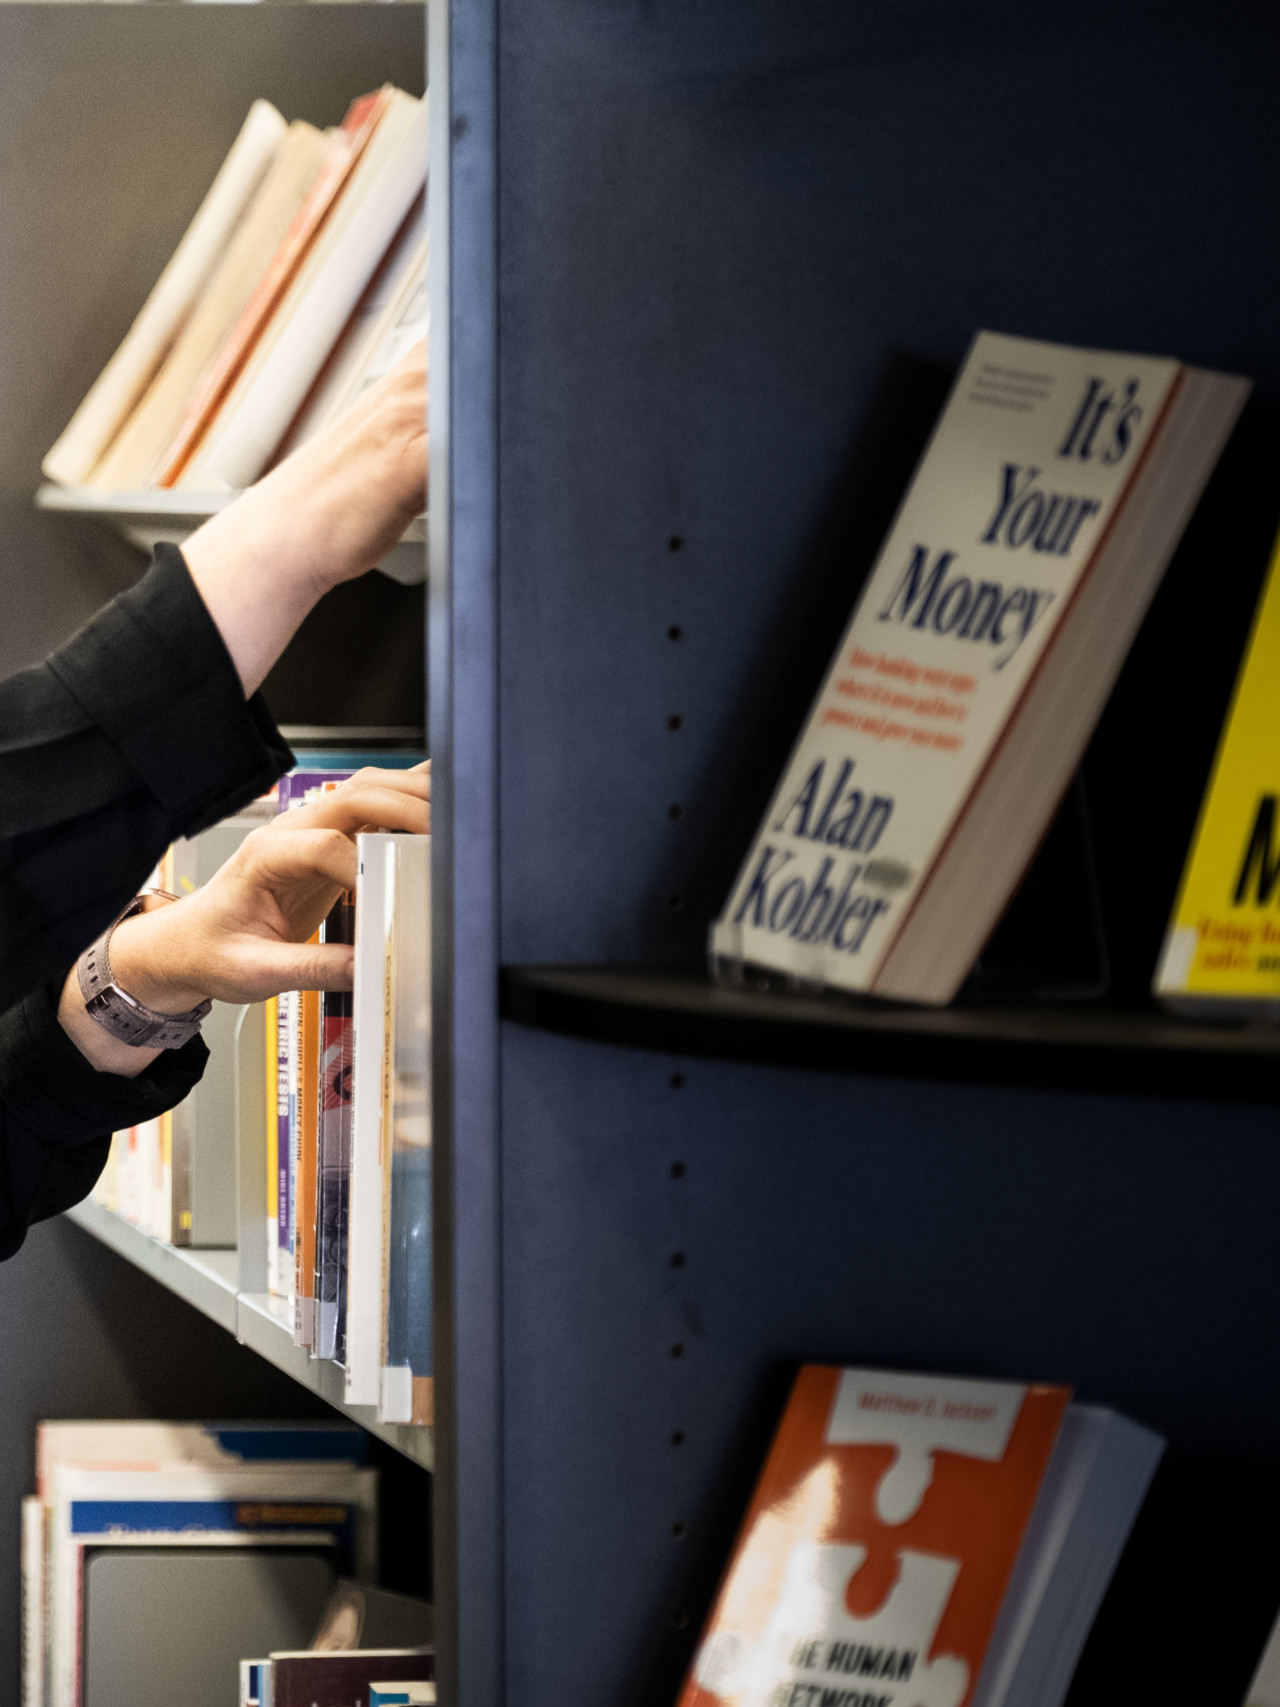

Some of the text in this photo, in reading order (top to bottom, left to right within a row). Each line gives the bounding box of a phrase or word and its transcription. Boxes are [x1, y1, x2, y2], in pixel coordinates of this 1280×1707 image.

[1058, 376, 1143, 467] It's
[980, 462, 1101, 556] Your
[878, 545, 1056, 671] Money
[771, 758, 897, 854] Alan
[736, 845, 891, 955] Kohler
[827, 1641, 919, 1684] HUMAN
